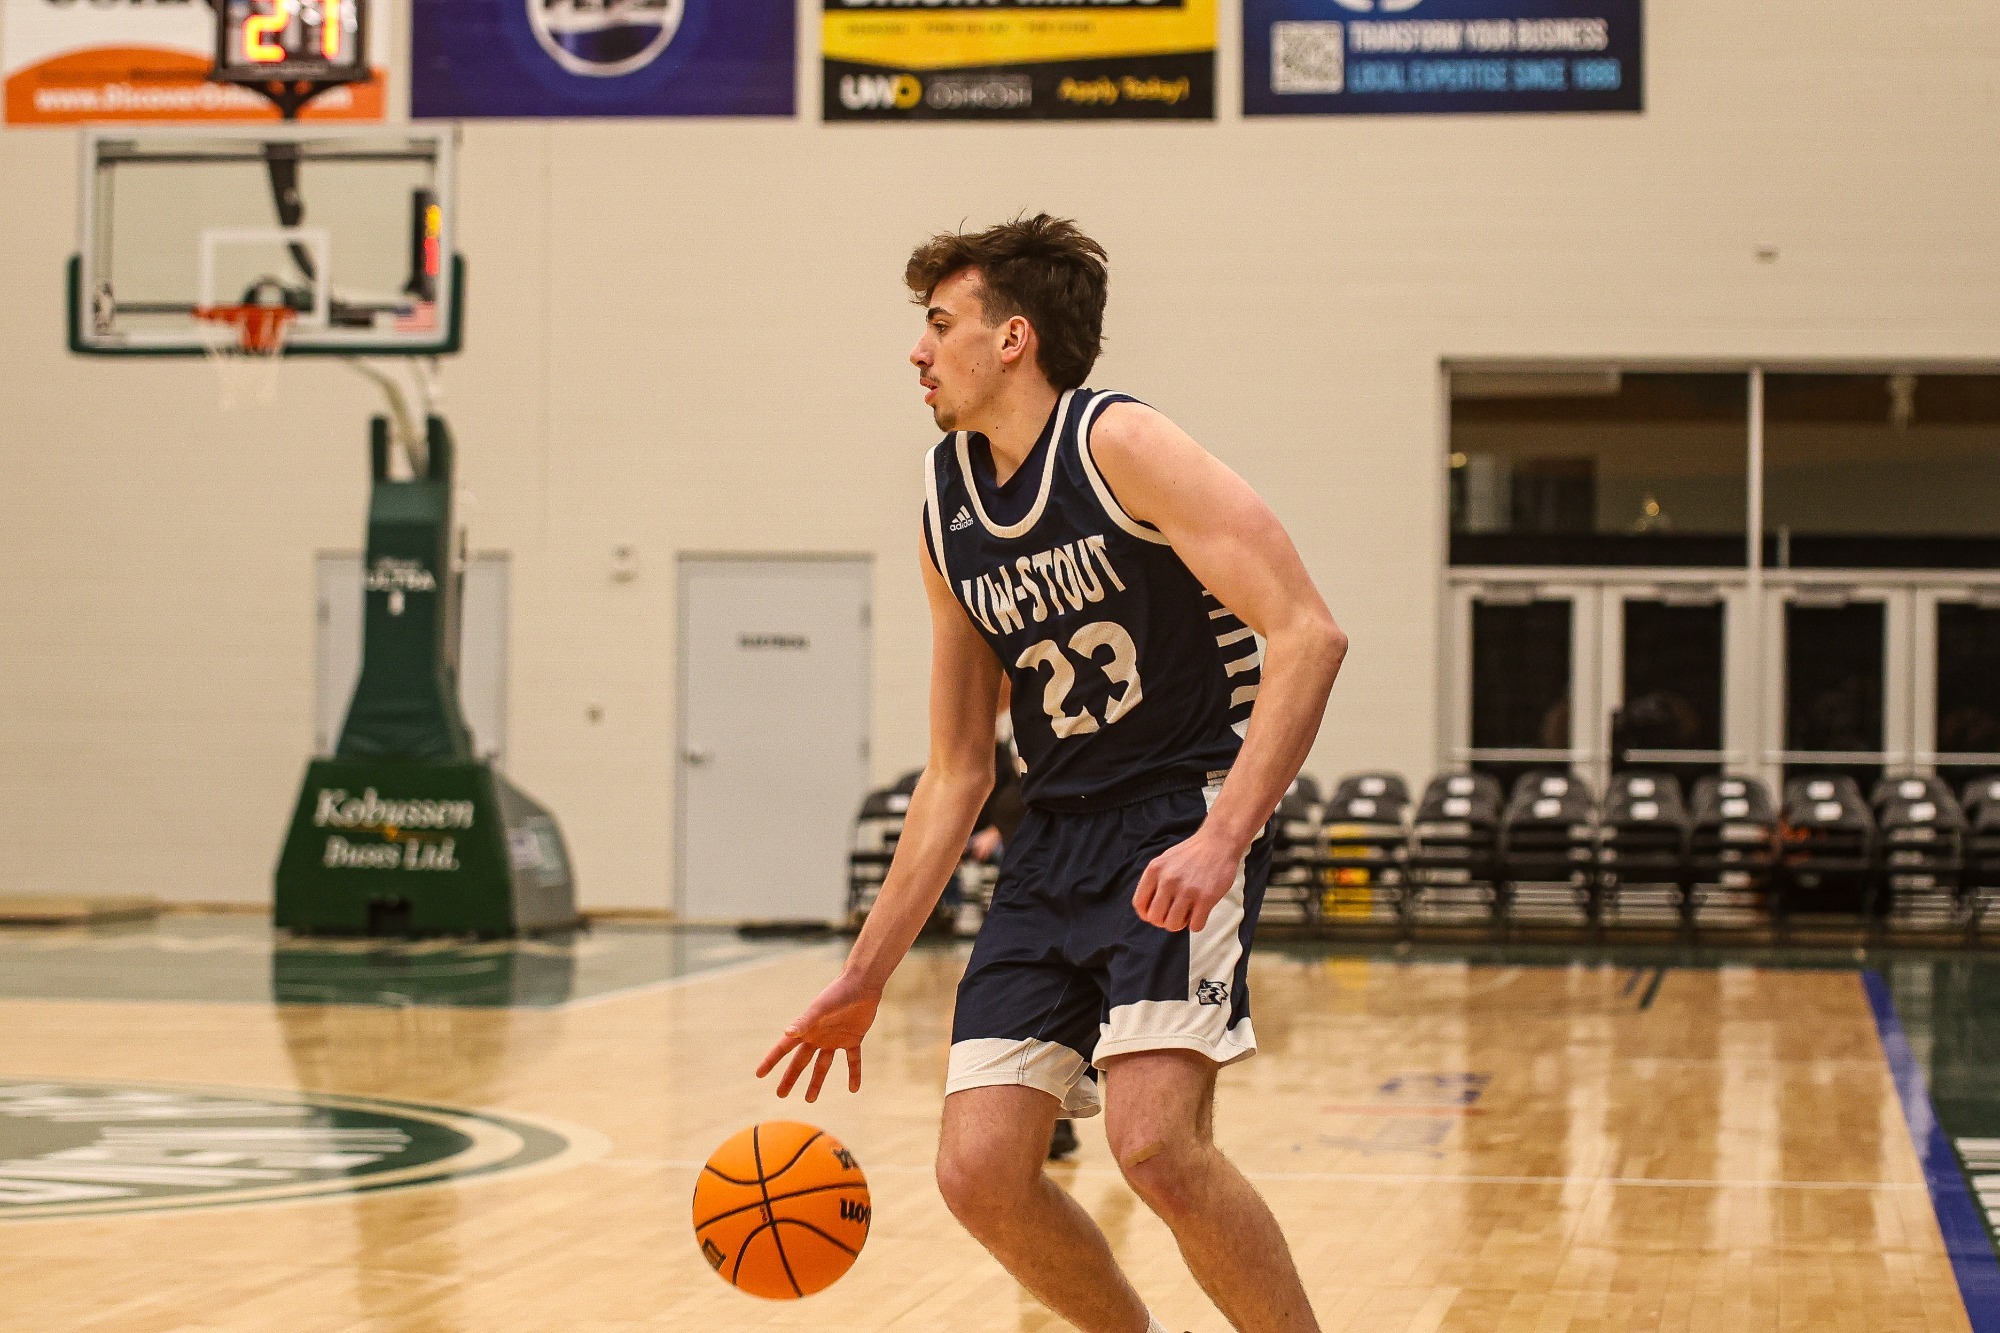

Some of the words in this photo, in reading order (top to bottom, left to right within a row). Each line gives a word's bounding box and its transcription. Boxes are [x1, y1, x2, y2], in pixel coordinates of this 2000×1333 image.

[1349, 20, 1462, 52] TRANSFORM
[1464, 20, 1514, 52] YOUR
[1515, 18, 1608, 51] BUSINESS
[840, 74, 922, 110] UWO
[1348, 60, 1404, 91] LOCAL
[1406, 59, 1508, 91] EXPERTISE
[1511, 58, 1568, 90] SINCE
[950, 518, 973, 531] adidas
[961, 534, 1126, 635] UW-STOUT
[1014, 621, 1144, 739] 23
[314, 787, 475, 829] Kobussen
[323, 835, 400, 869] Buses
[403, 838, 461, 871] Ltd.
